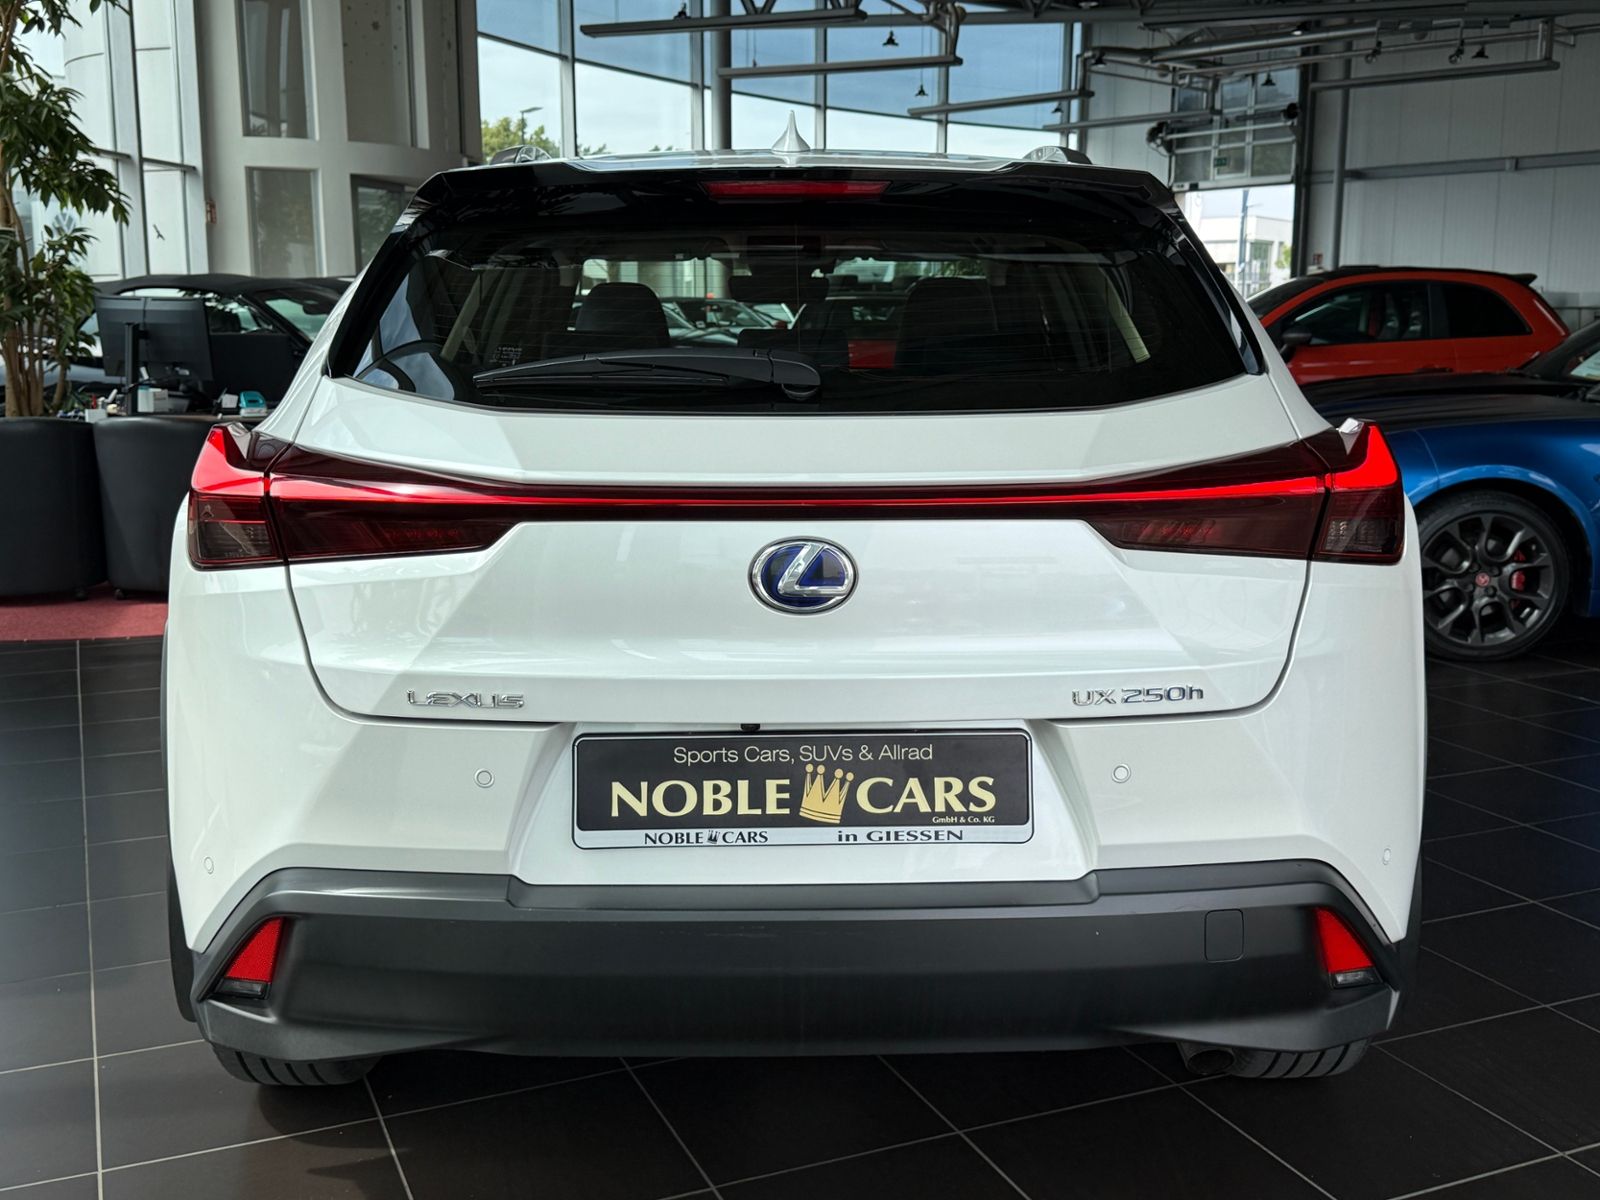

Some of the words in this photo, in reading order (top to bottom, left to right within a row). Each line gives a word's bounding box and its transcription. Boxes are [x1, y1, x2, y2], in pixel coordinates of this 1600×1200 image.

[406, 688, 524, 709] LEXUS
[1072, 689, 1117, 706] UX
[1121, 685, 1204, 704] 250h
[673, 746, 739, 767] Sports
[744, 745, 795, 765] Cars,
[799, 745, 853, 762] SUVs
[858, 744, 874, 761] &
[878, 744, 933, 760] Allrad
[611, 778, 791, 818] NOBLE
[856, 776, 997, 814] CARS
[967, 815, 981, 823] Co.
[983, 815, 996, 823] KG
[644, 831, 704, 845] NOBLE
[722, 830, 769, 844] CARS
[837, 830, 858, 842] in
[866, 829, 963, 842] GIESSEN
